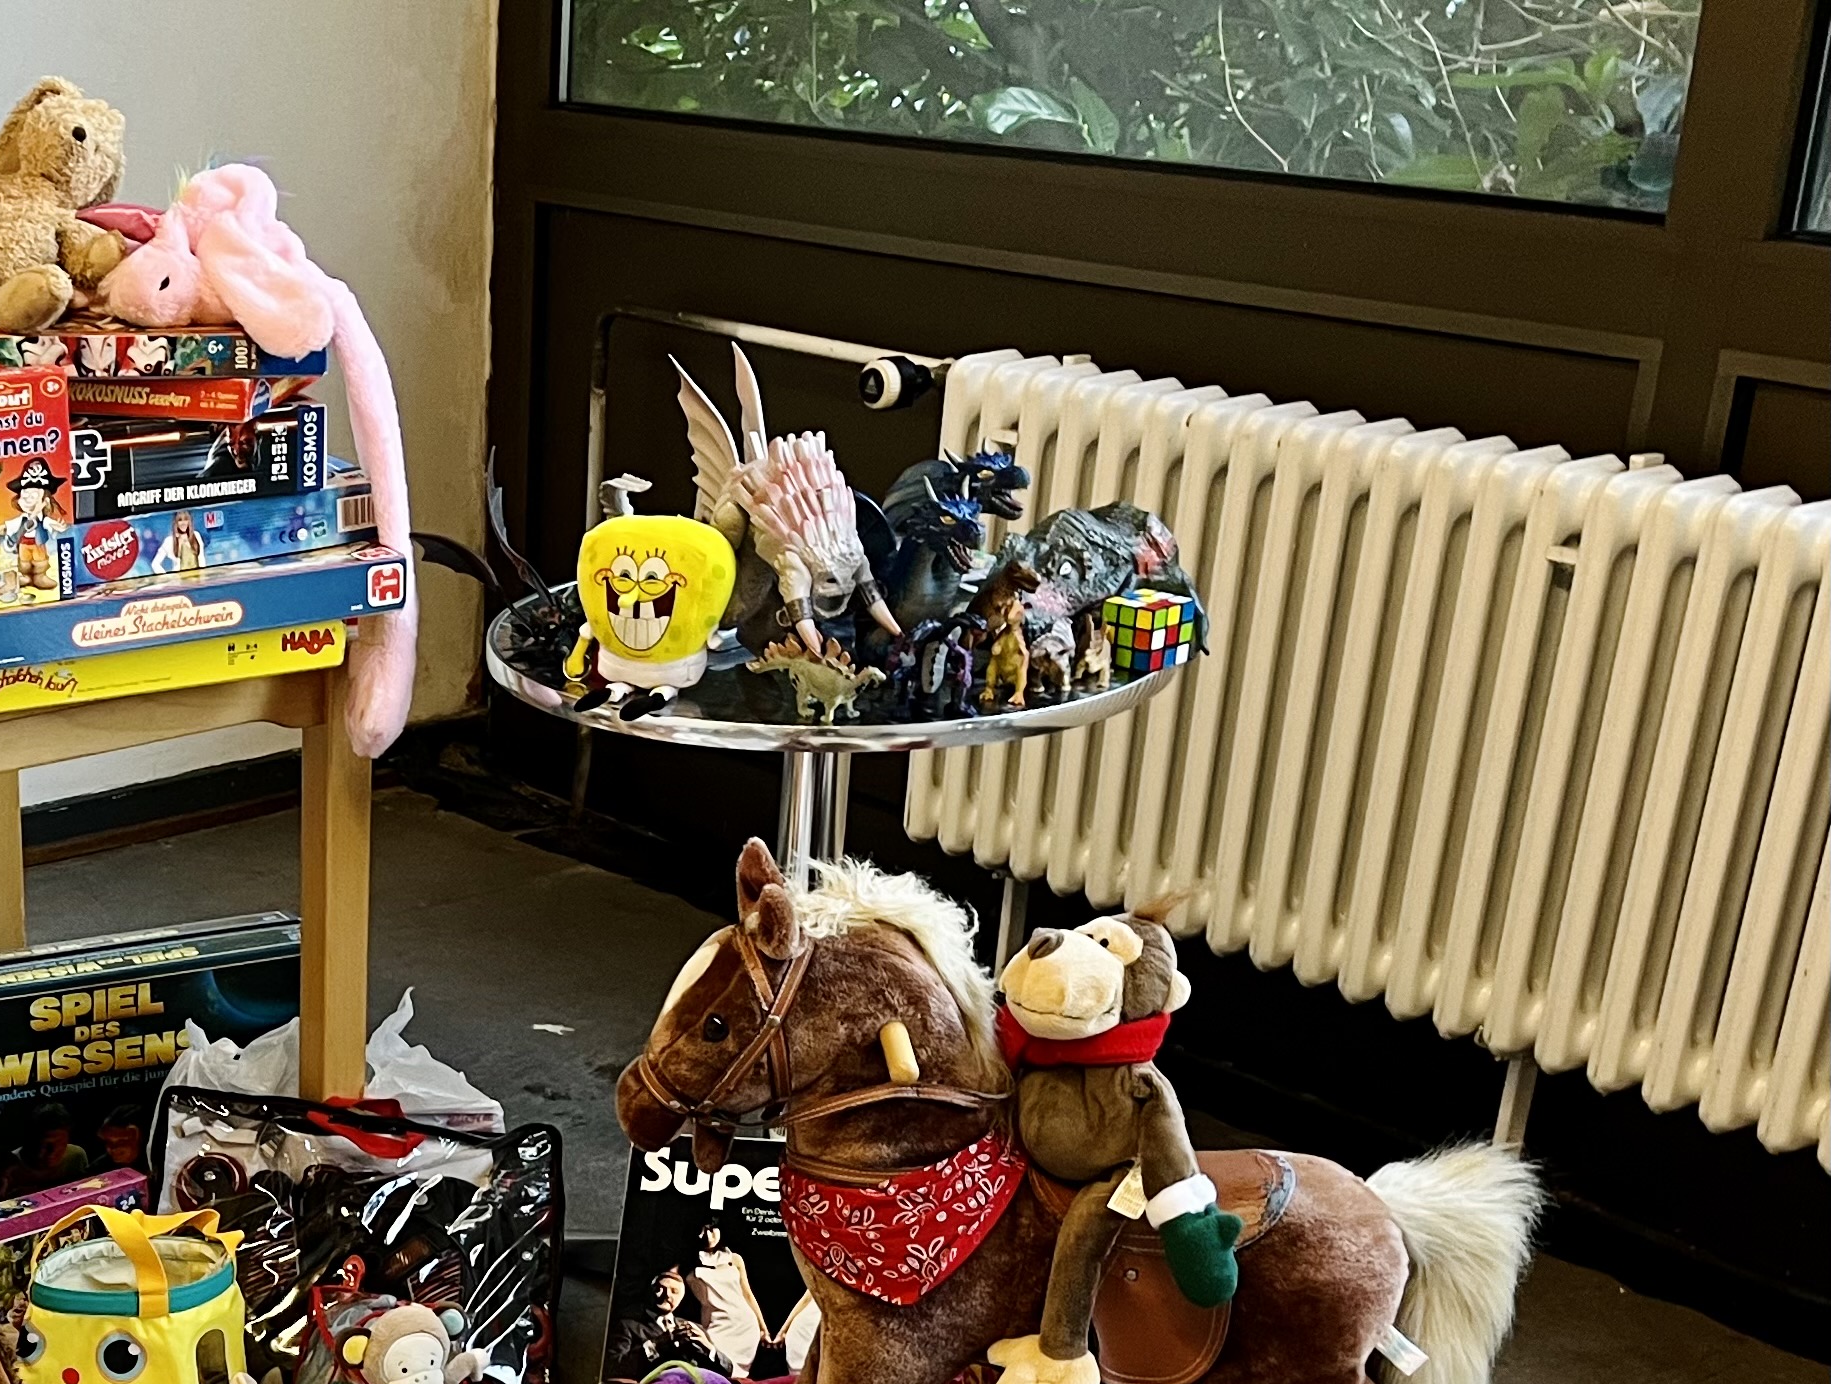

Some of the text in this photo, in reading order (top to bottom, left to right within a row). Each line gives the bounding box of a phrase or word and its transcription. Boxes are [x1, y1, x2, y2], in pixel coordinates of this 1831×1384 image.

[234, 345, 249, 370] 100
[68, 382, 150, 405] KOKOSNUSS
[24, 411, 45, 427] du
[303, 410, 318, 489] KOSMOS
[117, 478, 257, 508] ANGRIFF DER KLONKRIEGER
[80, 525, 137, 567] Twister
[96, 548, 131, 571] moves
[60, 541, 72, 596] KOSMOS
[80, 606, 235, 643] kleines Stachelschwein
[281, 629, 336, 656] HABA
[29, 982, 165, 1033] SPIEL
[74, 1020, 121, 1043] DES
[40, 1074, 97, 1098] Quizspiel
[99, 1071, 120, 1088] für
[122, 1068, 143, 1085] die
[144, 1066, 170, 1086] jun
